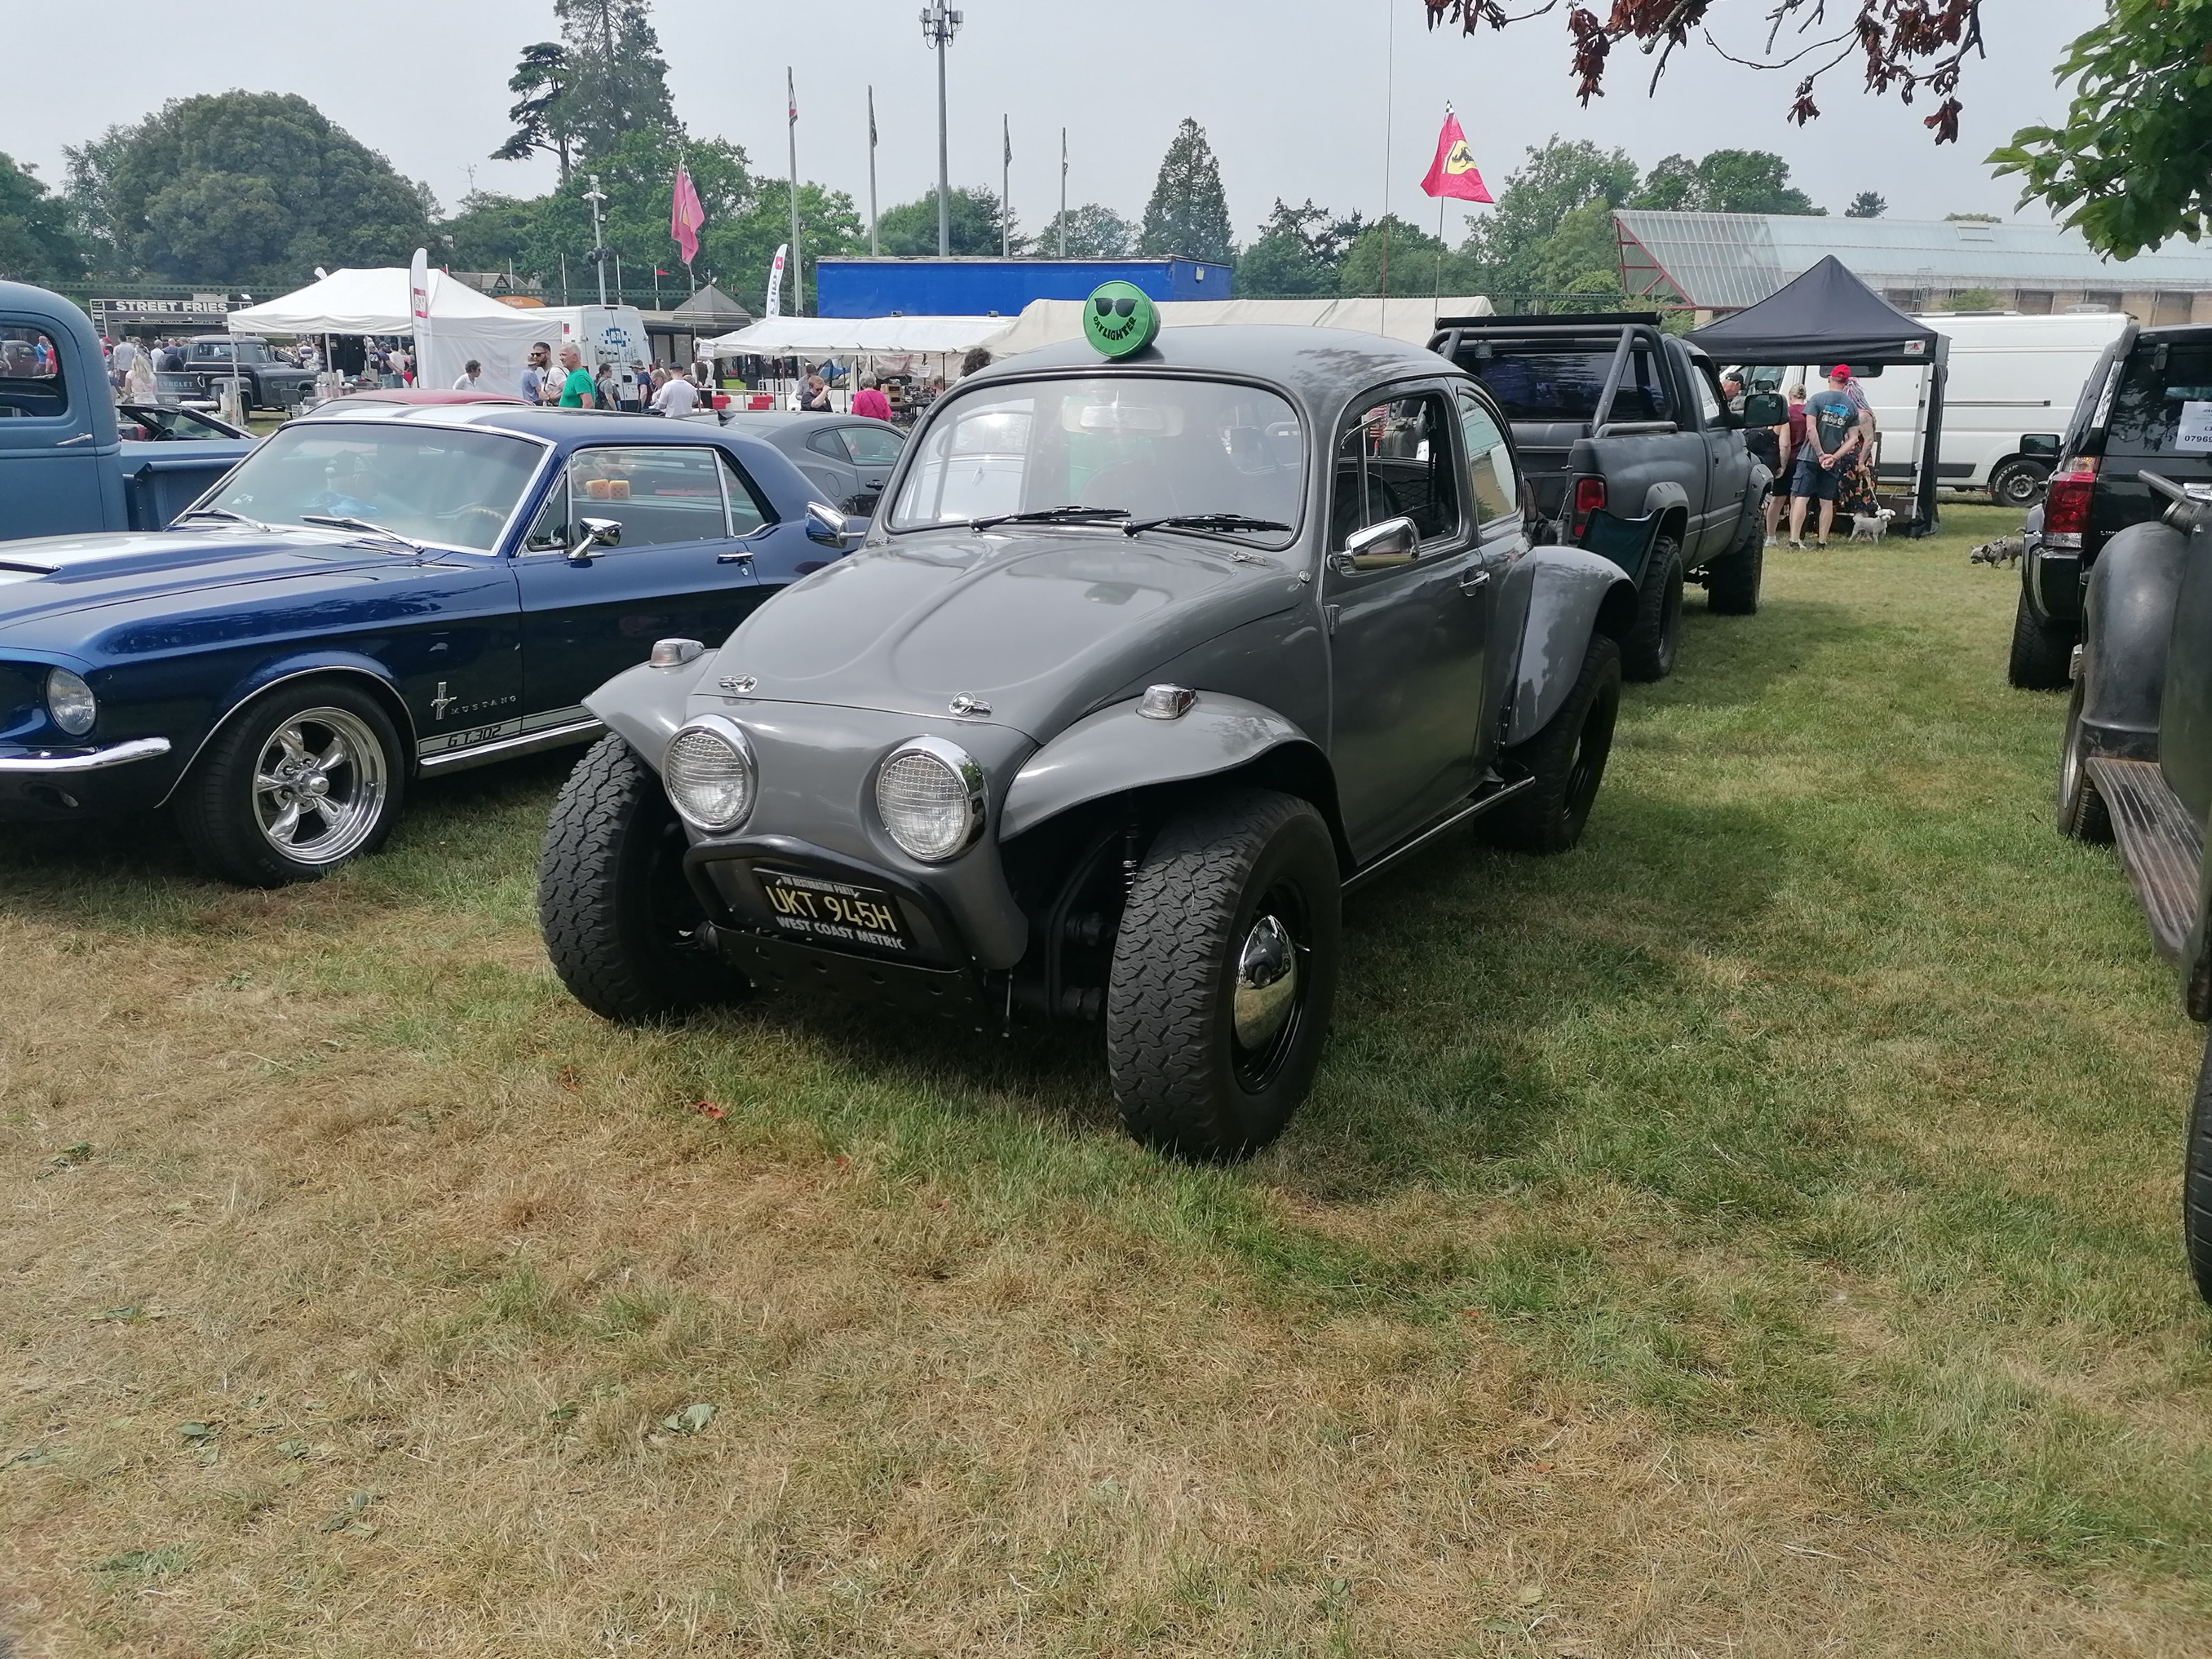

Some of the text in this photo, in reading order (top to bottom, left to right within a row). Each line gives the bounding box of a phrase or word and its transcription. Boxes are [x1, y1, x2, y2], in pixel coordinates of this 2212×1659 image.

[116, 301, 228, 312] STREET FRIES
[1093, 315, 1137, 341] DAYLIGHTER
[451, 695, 516, 715] MUSTANG
[765, 885, 897, 932] UKT 945H
[776, 916, 906, 950] WEST COAST METRIC
